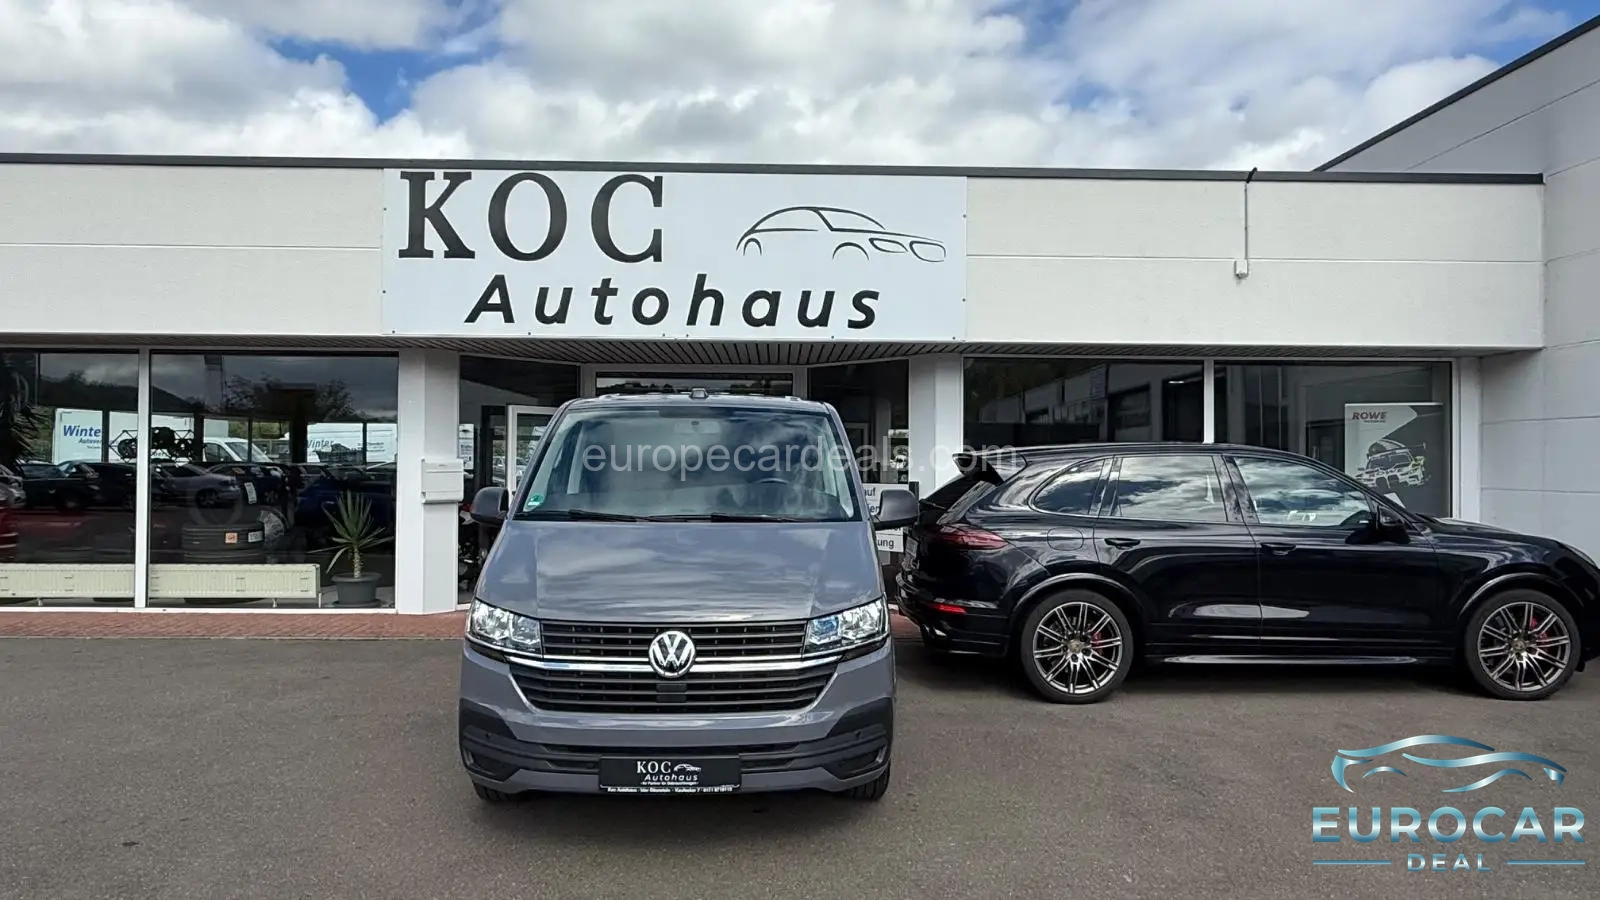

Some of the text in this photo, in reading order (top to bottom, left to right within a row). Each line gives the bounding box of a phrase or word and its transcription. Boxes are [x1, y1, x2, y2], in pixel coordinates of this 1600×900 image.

[398, 171, 663, 263] KOC
[464, 273, 881, 329] Autohaus
[1352, 411, 1387, 420] ROWE
[63, 425, 101, 437] Winte
[877, 539, 894, 549] ung
[636, 761, 671, 774] KOC
